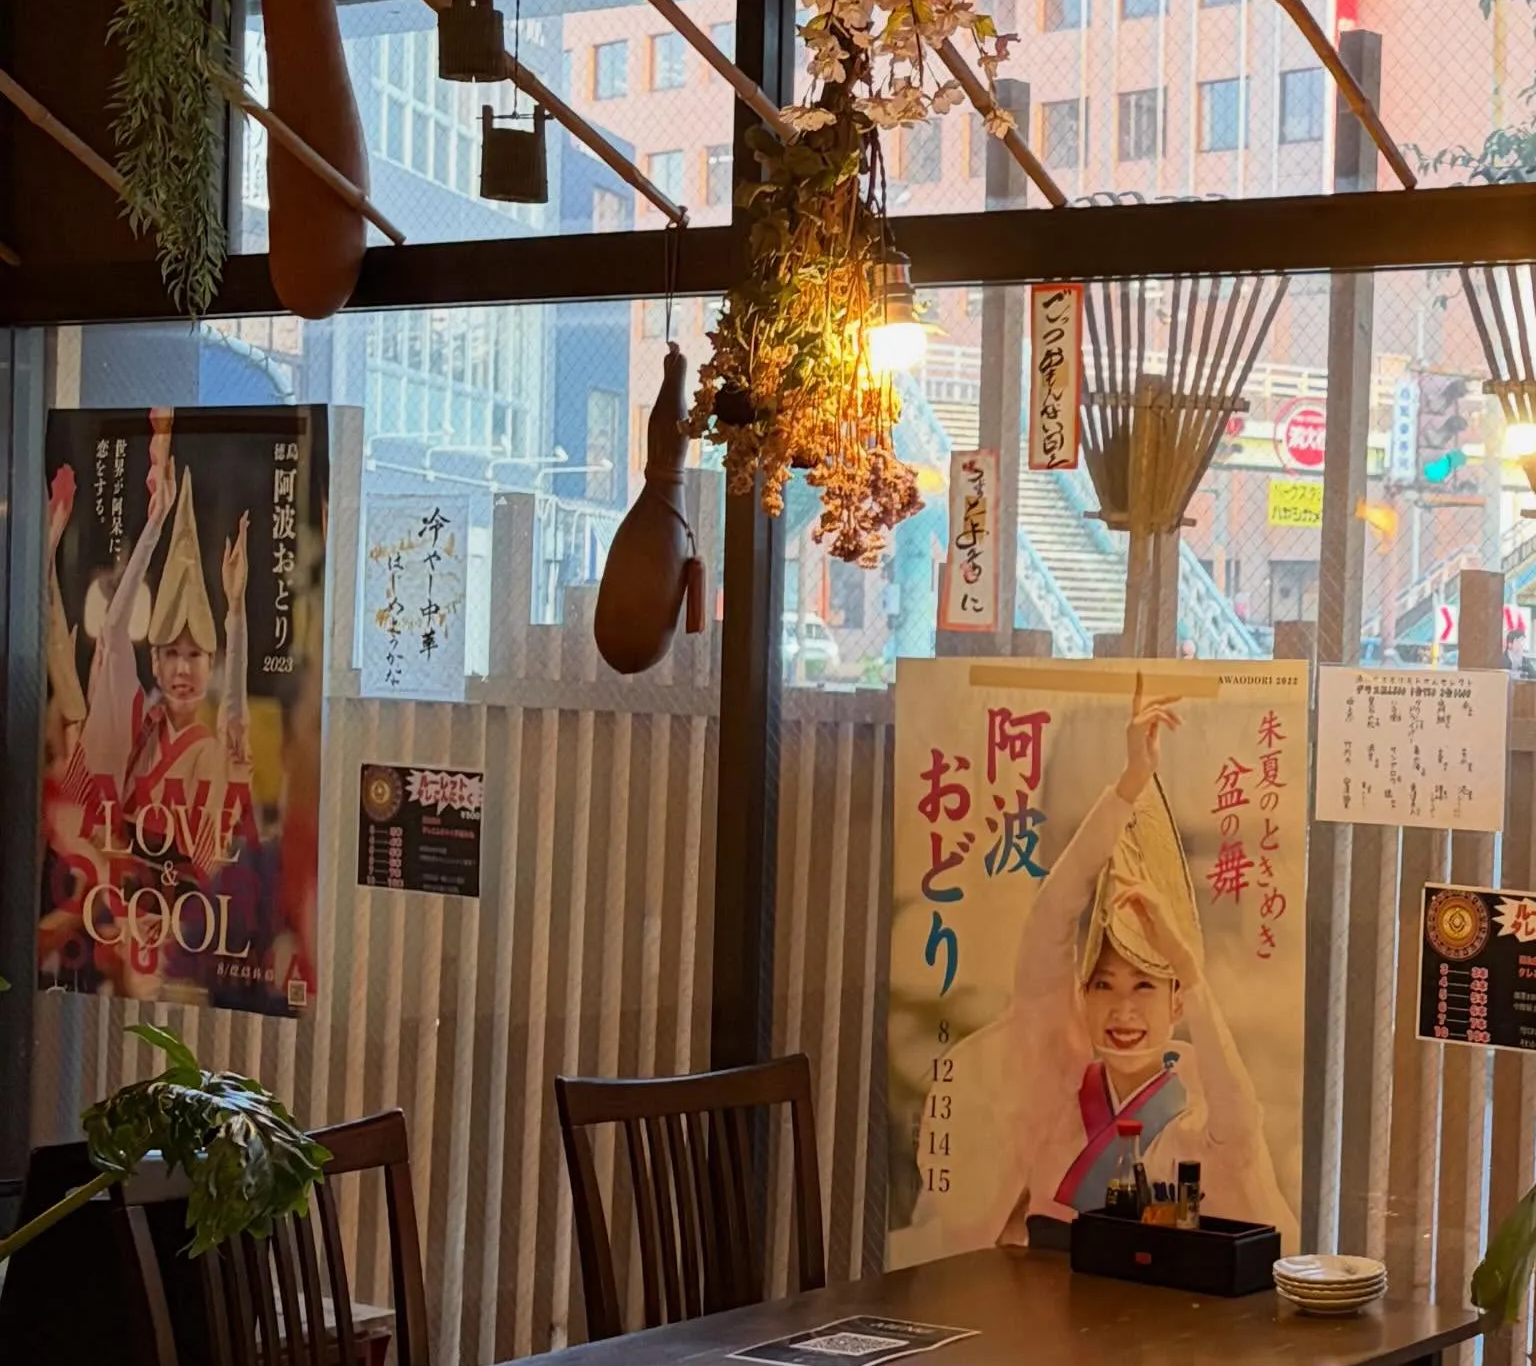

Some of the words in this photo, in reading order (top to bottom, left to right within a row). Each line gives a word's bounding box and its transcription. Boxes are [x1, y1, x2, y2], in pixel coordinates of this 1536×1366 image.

[272, 468, 298, 650] 阿波おどり
[263, 656, 294, 673] 2023
[1218, 675, 1272, 685] AWAODORI
[984, 706, 1052, 880] 阿波
[102, 800, 241, 863] LOVE
[1207, 756, 1255, 906] 盆の舞
[1256, 709, 1288, 960] 朱夏のときめき
[160, 860, 179, 886] &
[917, 747, 973, 998] おどり
[83, 884, 250, 958] COOL
[937, 1020, 950, 1045] 8
[930, 1058, 955, 1084] 12
[929, 1095, 952, 1121] 13
[928, 1132, 951, 1157] 14
[927, 1168, 951, 1194] 15
